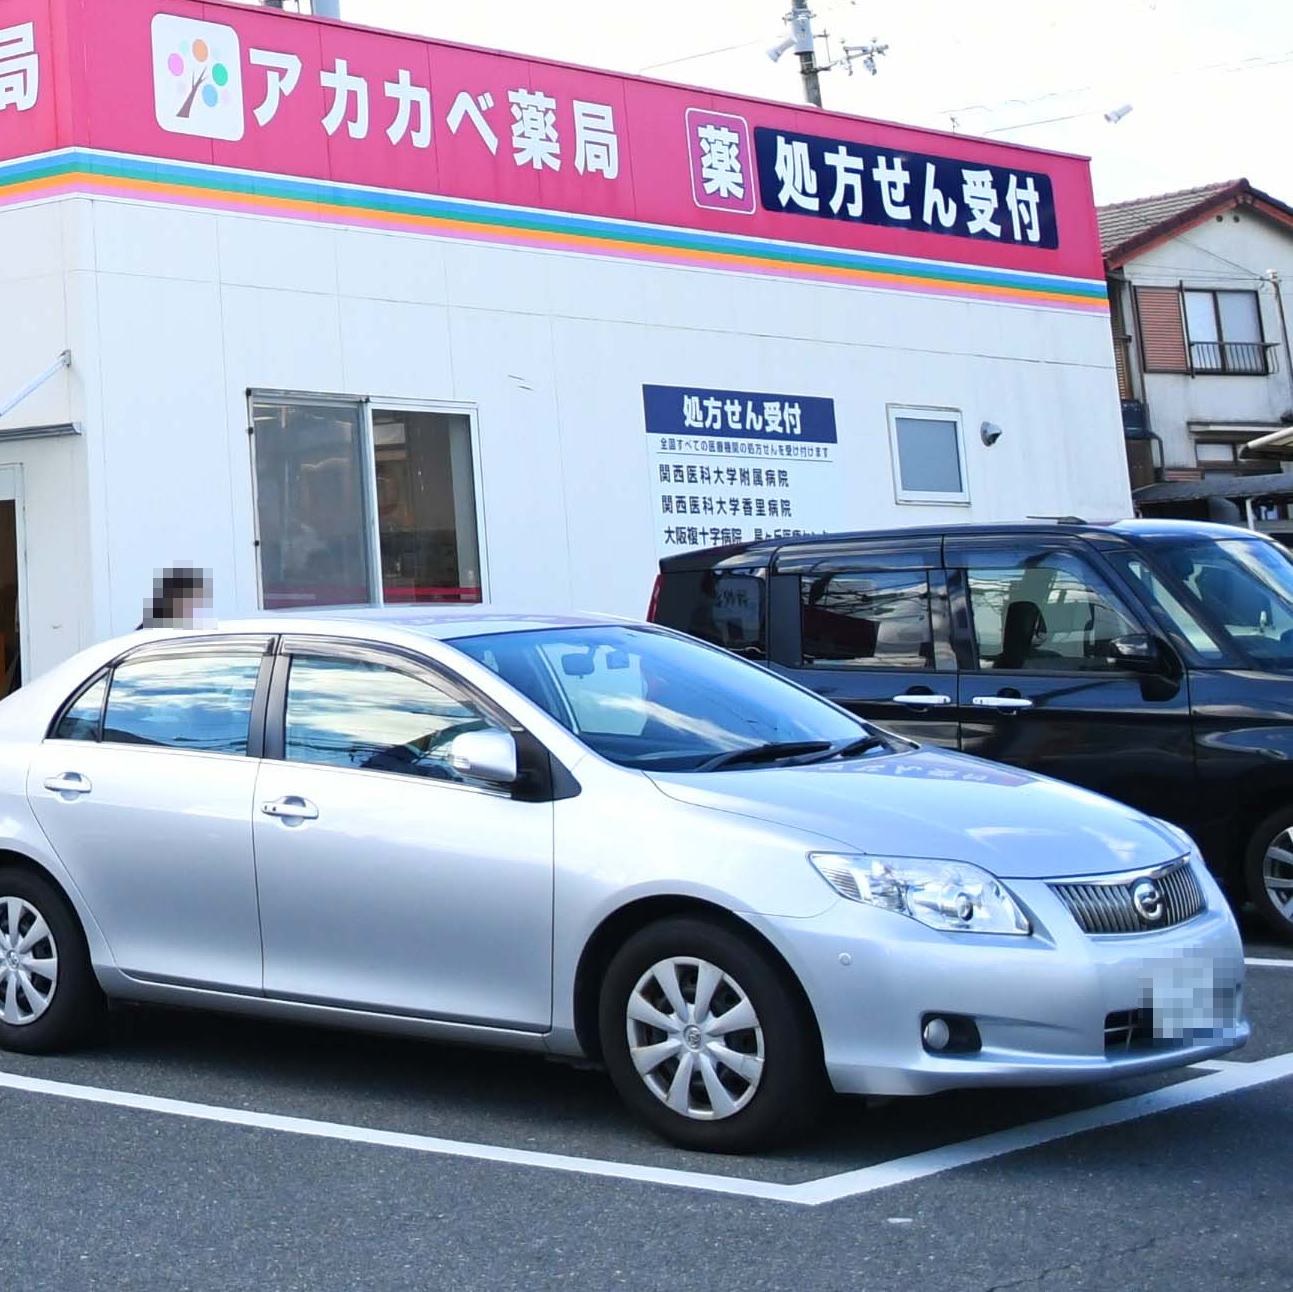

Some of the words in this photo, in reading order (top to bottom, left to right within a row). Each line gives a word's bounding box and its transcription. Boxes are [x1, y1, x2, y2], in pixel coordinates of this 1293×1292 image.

[249, 47, 620, 179] アカカベ薬局
[697, 123, 746, 199] 薬
[774, 135, 1041, 243] 処方せん受付
[682, 395, 802, 435] 処方せん受付
[659, 464, 790, 488] 関西医科大学附属病院
[661, 494, 793, 518] 関西医科大学香里病院
[663, 525, 743, 546] 大阪複十字病院
